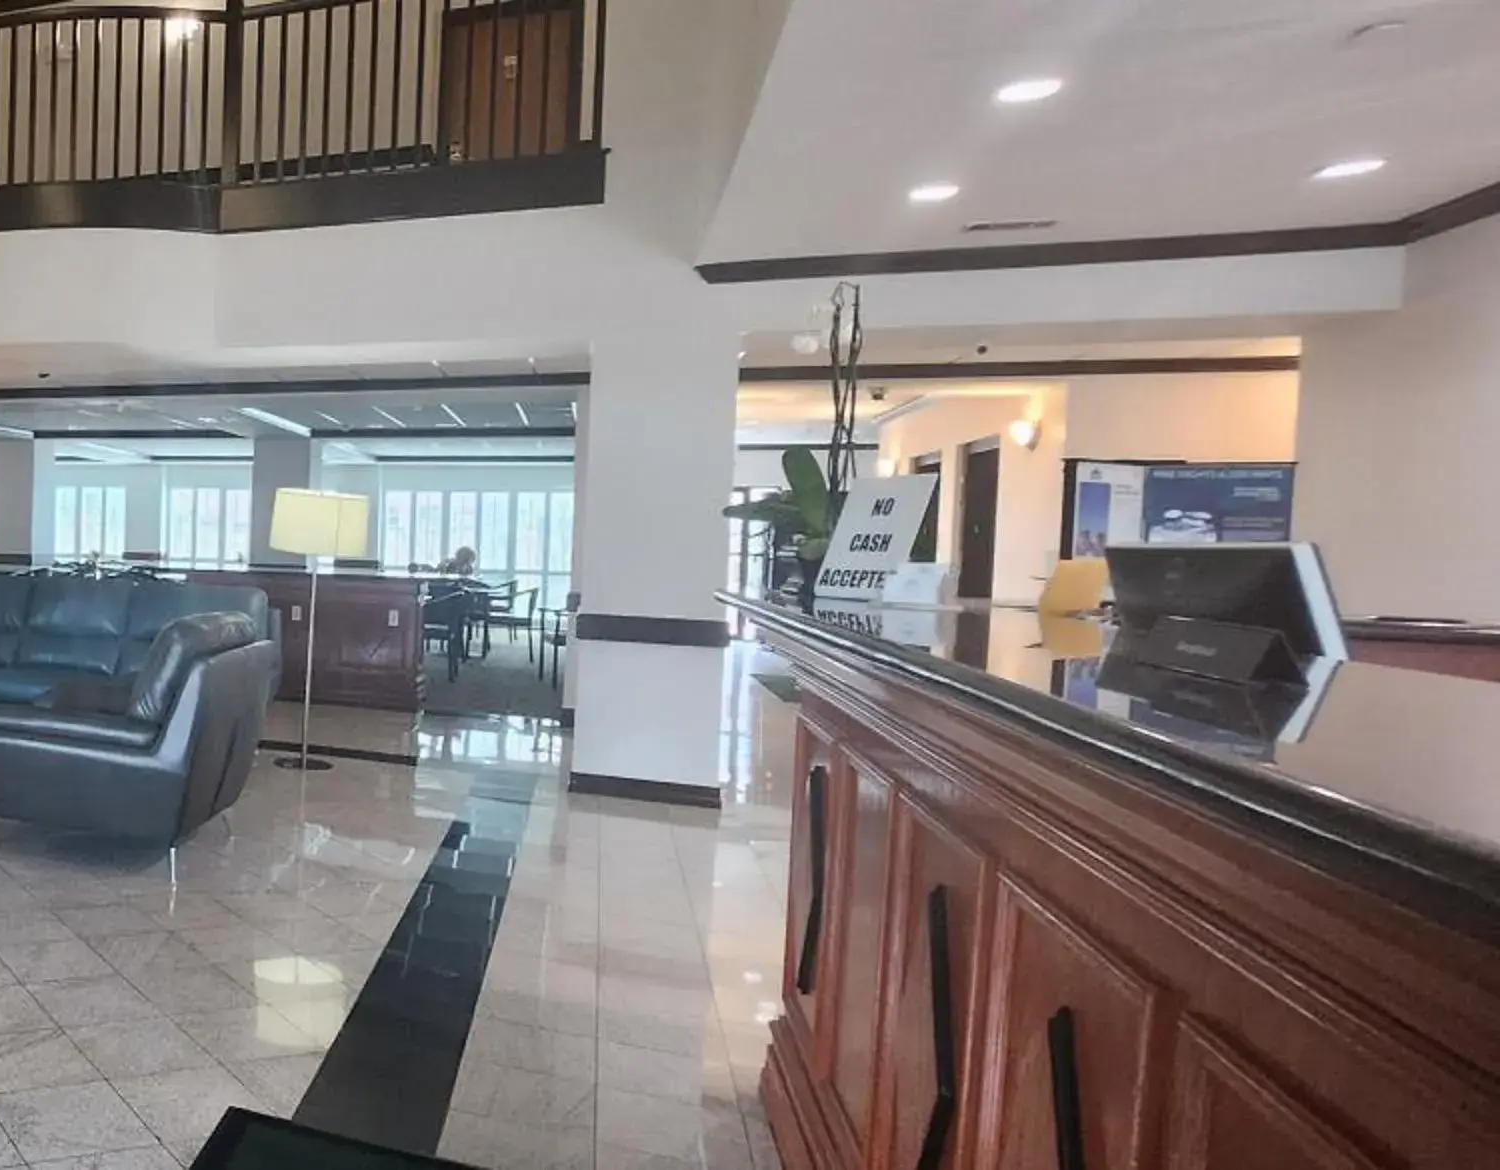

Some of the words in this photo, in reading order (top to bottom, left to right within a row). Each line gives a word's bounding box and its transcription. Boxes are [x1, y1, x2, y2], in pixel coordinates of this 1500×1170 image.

[871, 497, 895, 517] NO
[850, 533, 892, 552] CASH
[819, 569, 897, 589] ACCEPTE
